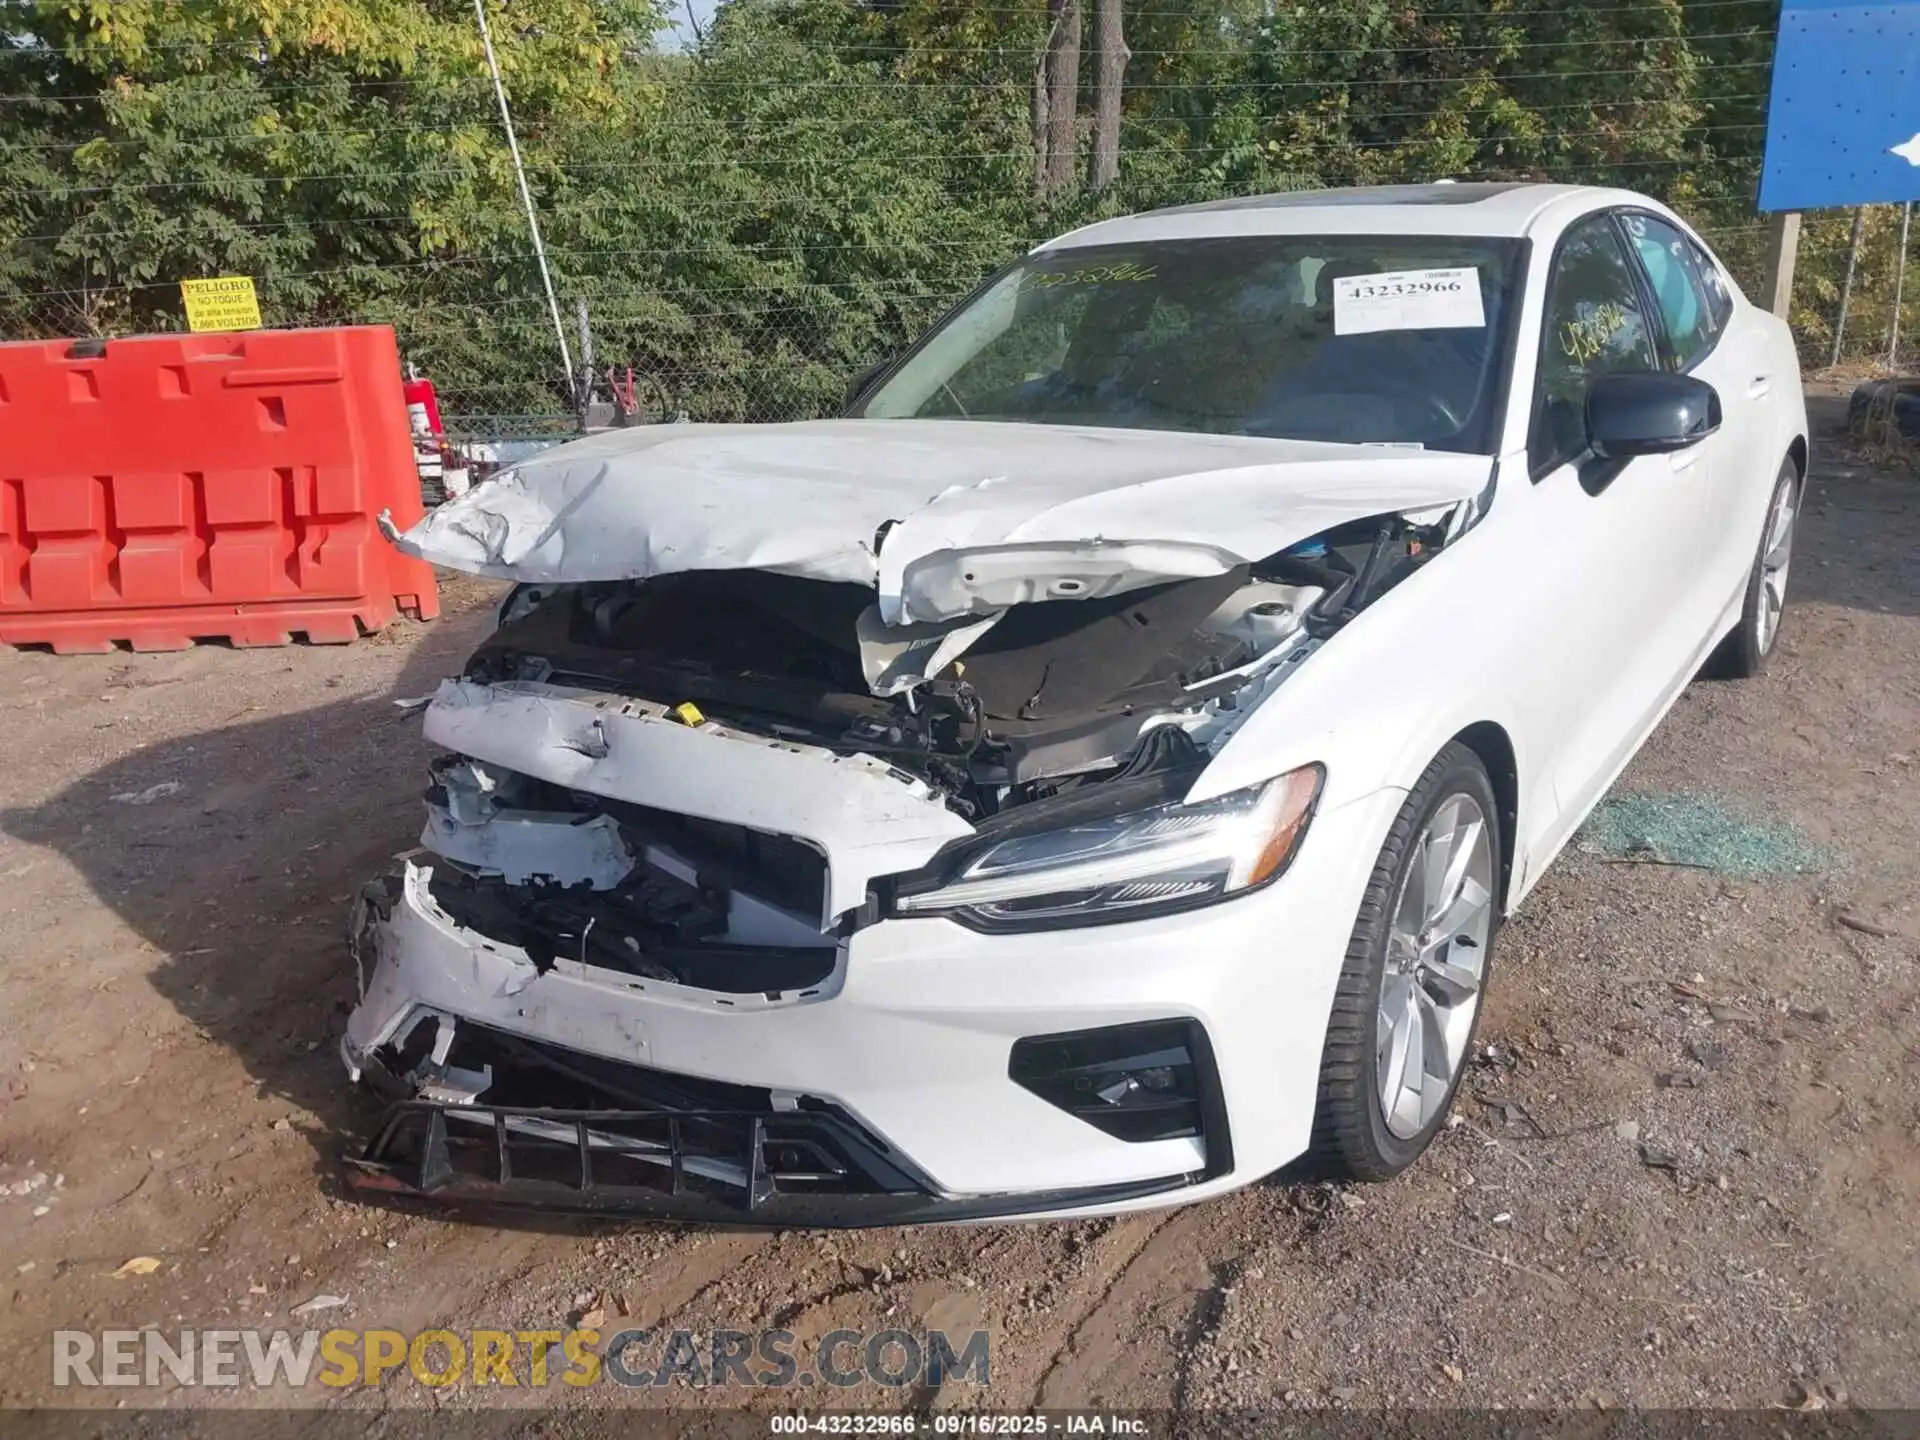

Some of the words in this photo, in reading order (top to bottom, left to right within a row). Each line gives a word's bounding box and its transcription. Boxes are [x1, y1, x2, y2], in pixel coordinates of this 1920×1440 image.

[186, 280, 251, 294] PELIGRO
[1348, 281, 1461, 298] 43232966
[213, 294, 245, 305] TOQUE
